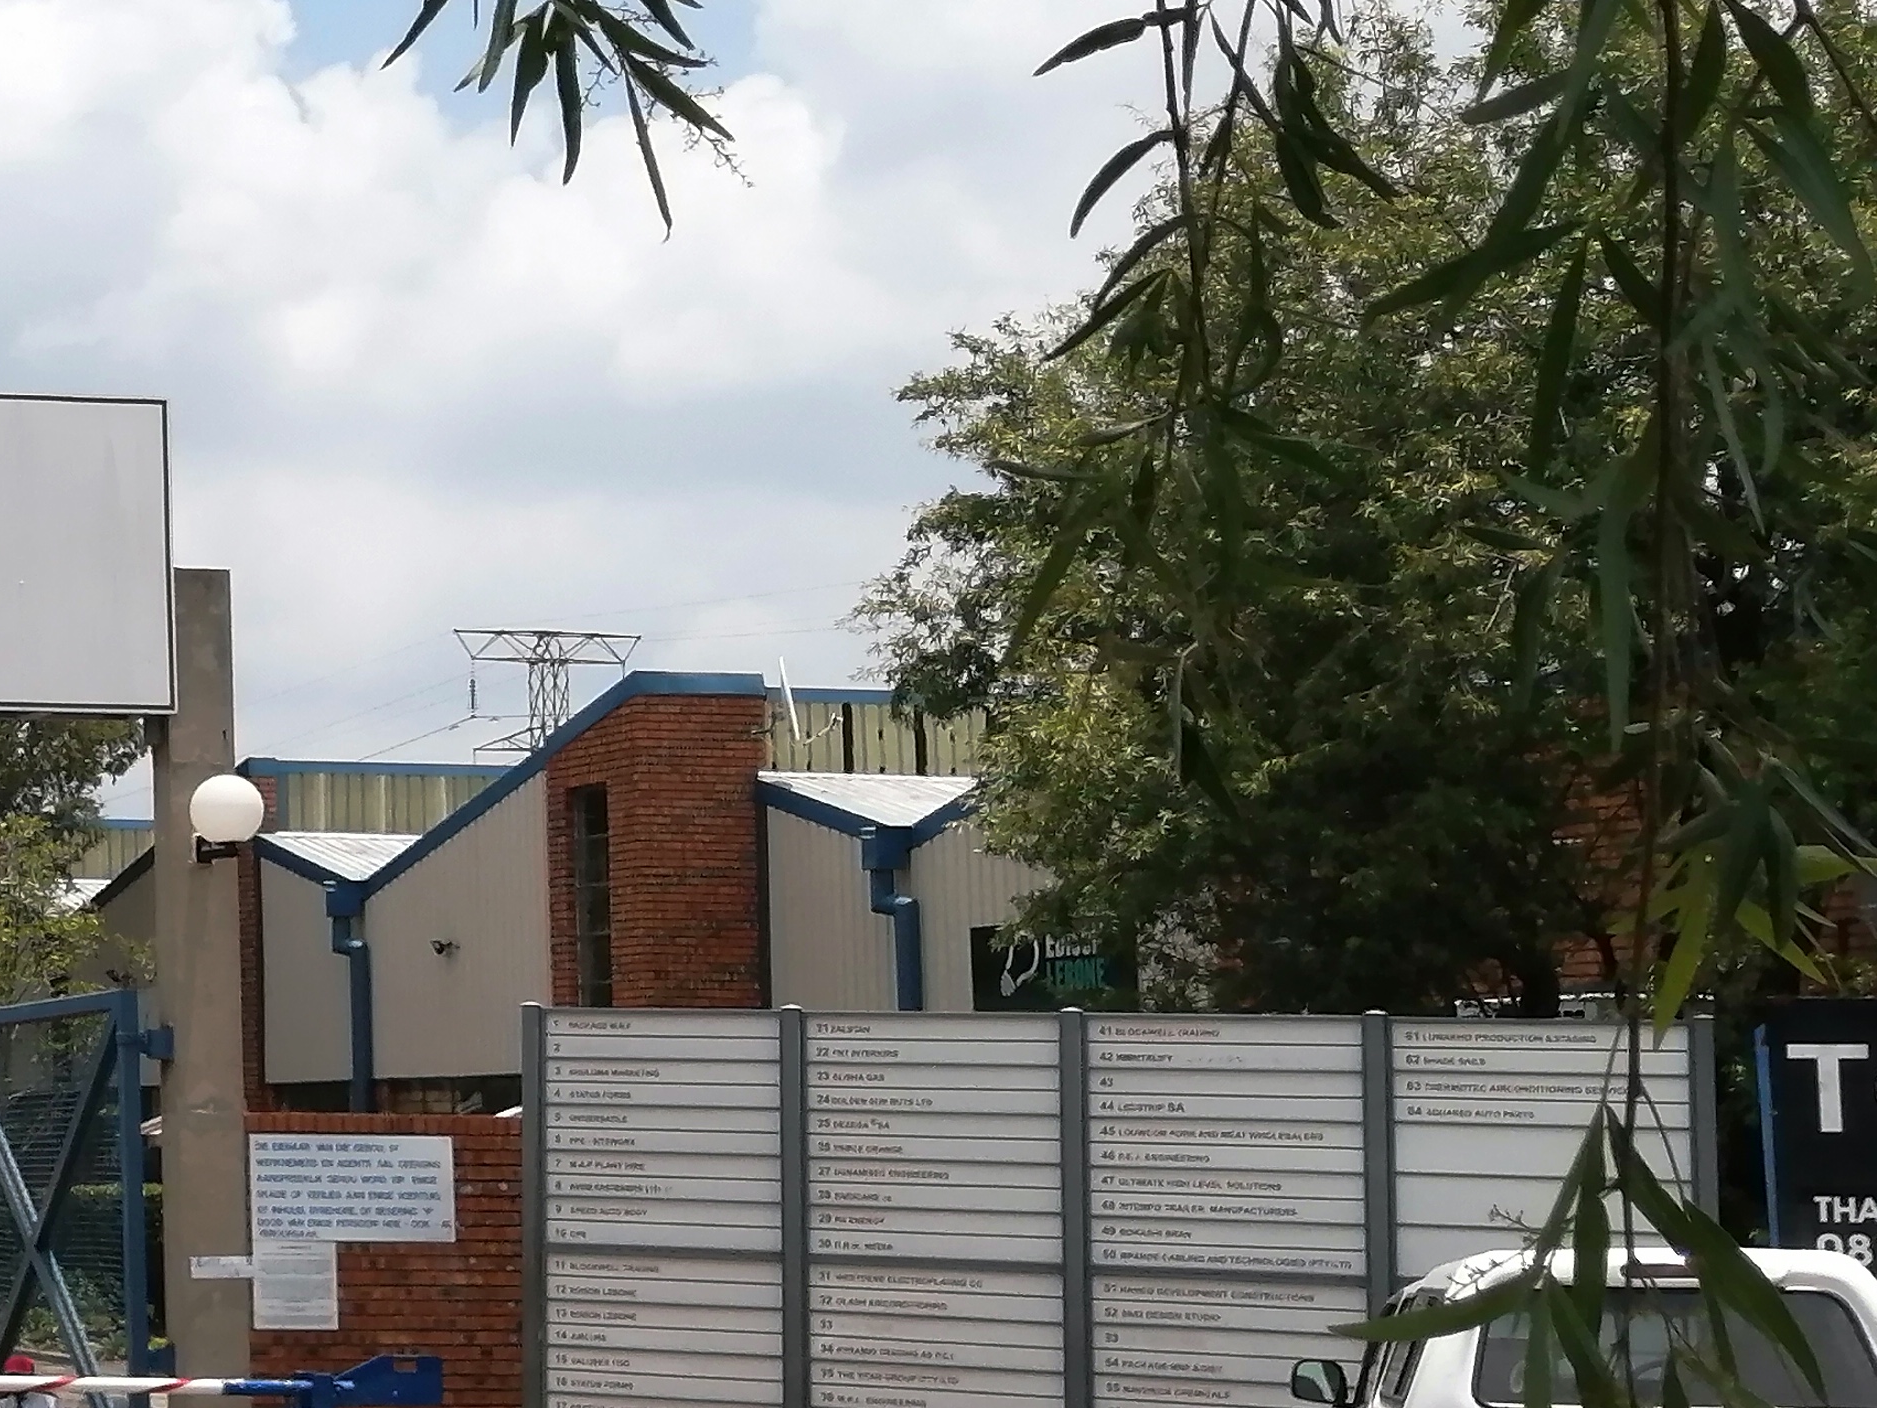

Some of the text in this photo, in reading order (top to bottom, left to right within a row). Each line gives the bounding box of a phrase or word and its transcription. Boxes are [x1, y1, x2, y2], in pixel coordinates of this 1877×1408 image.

[1099, 1026, 1111, 1036] 41
[1100, 1053, 1113, 1062] 42
[817, 1071, 829, 1080] 23
[1099, 1078, 1113, 1088] 43
[817, 1095, 830, 1104] 24
[1100, 1102, 1114, 1111] 44
[1100, 1127, 1115, 1136] 45
[818, 1167, 831, 1176] 27
[1101, 1177, 1114, 1186] 47
[555, 1261, 565, 1269] 11
[555, 1285, 566, 1293] 12
[1105, 1308, 1118, 1317] 52
